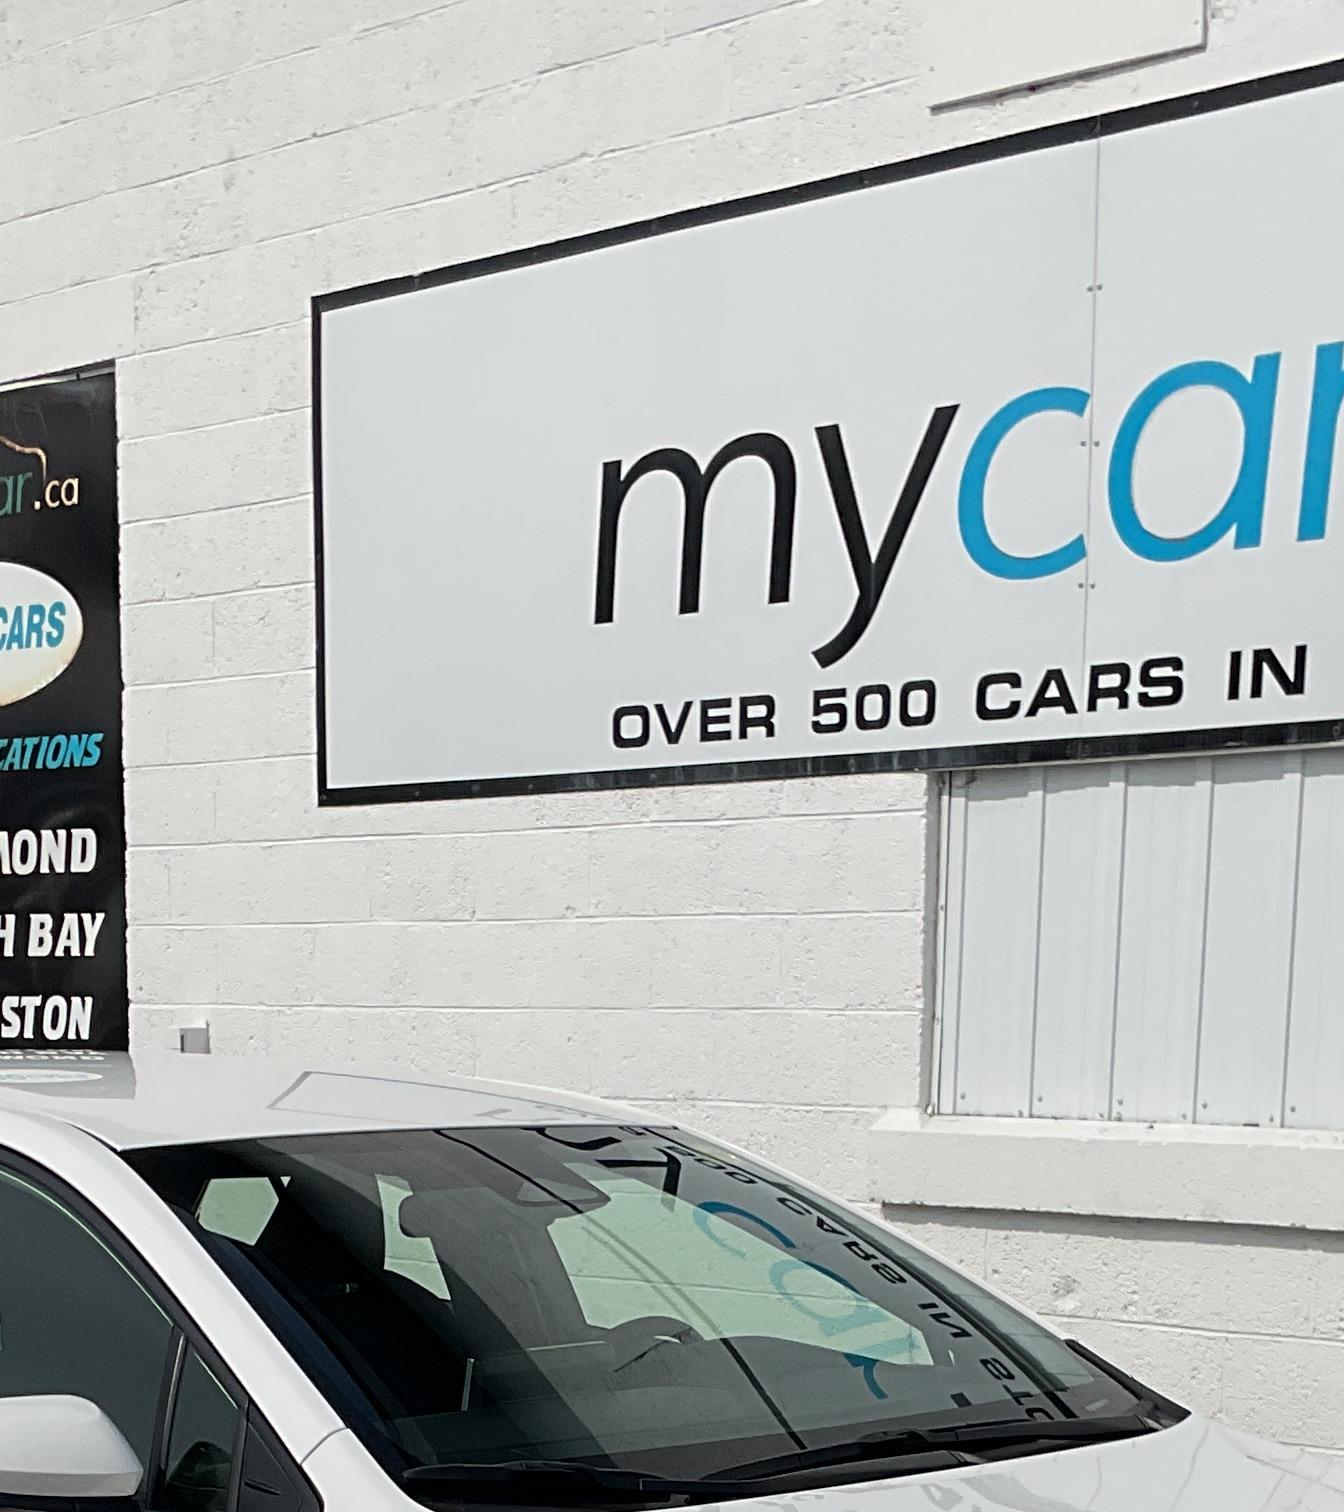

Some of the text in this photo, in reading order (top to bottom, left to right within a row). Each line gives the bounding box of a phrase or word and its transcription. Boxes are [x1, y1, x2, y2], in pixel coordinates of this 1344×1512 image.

[612, 694, 776, 750] OVER
[810, 678, 938, 738] 500
[974, 655, 1185, 722] CARS
[1226, 643, 1308, 702] IN
[27, 912, 106, 957] BAY
